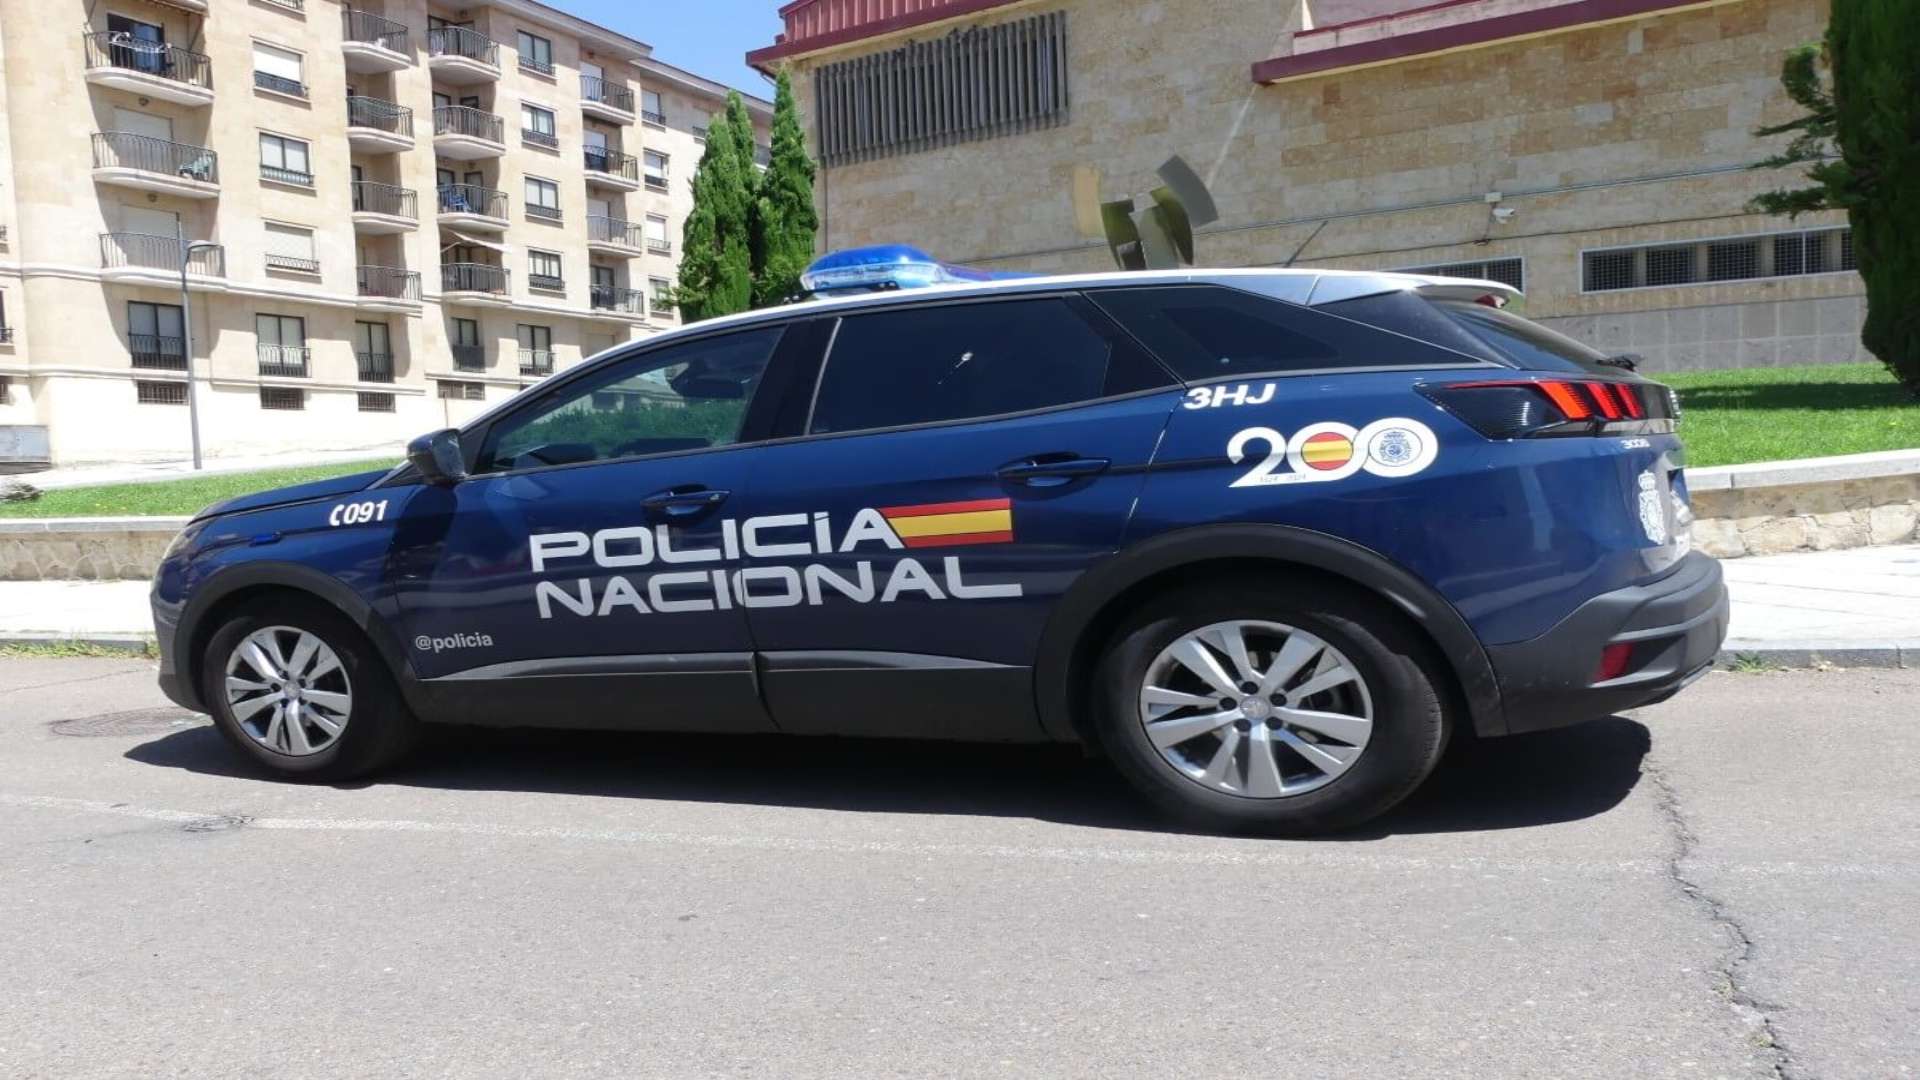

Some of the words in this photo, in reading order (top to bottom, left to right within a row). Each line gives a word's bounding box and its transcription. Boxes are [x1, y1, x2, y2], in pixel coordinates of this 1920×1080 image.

[1184, 383, 1276, 410] 3HJ
[329, 500, 387, 527] C091
[535, 556, 1023, 619] NACIONAL
[415, 632, 494, 653] @policia
